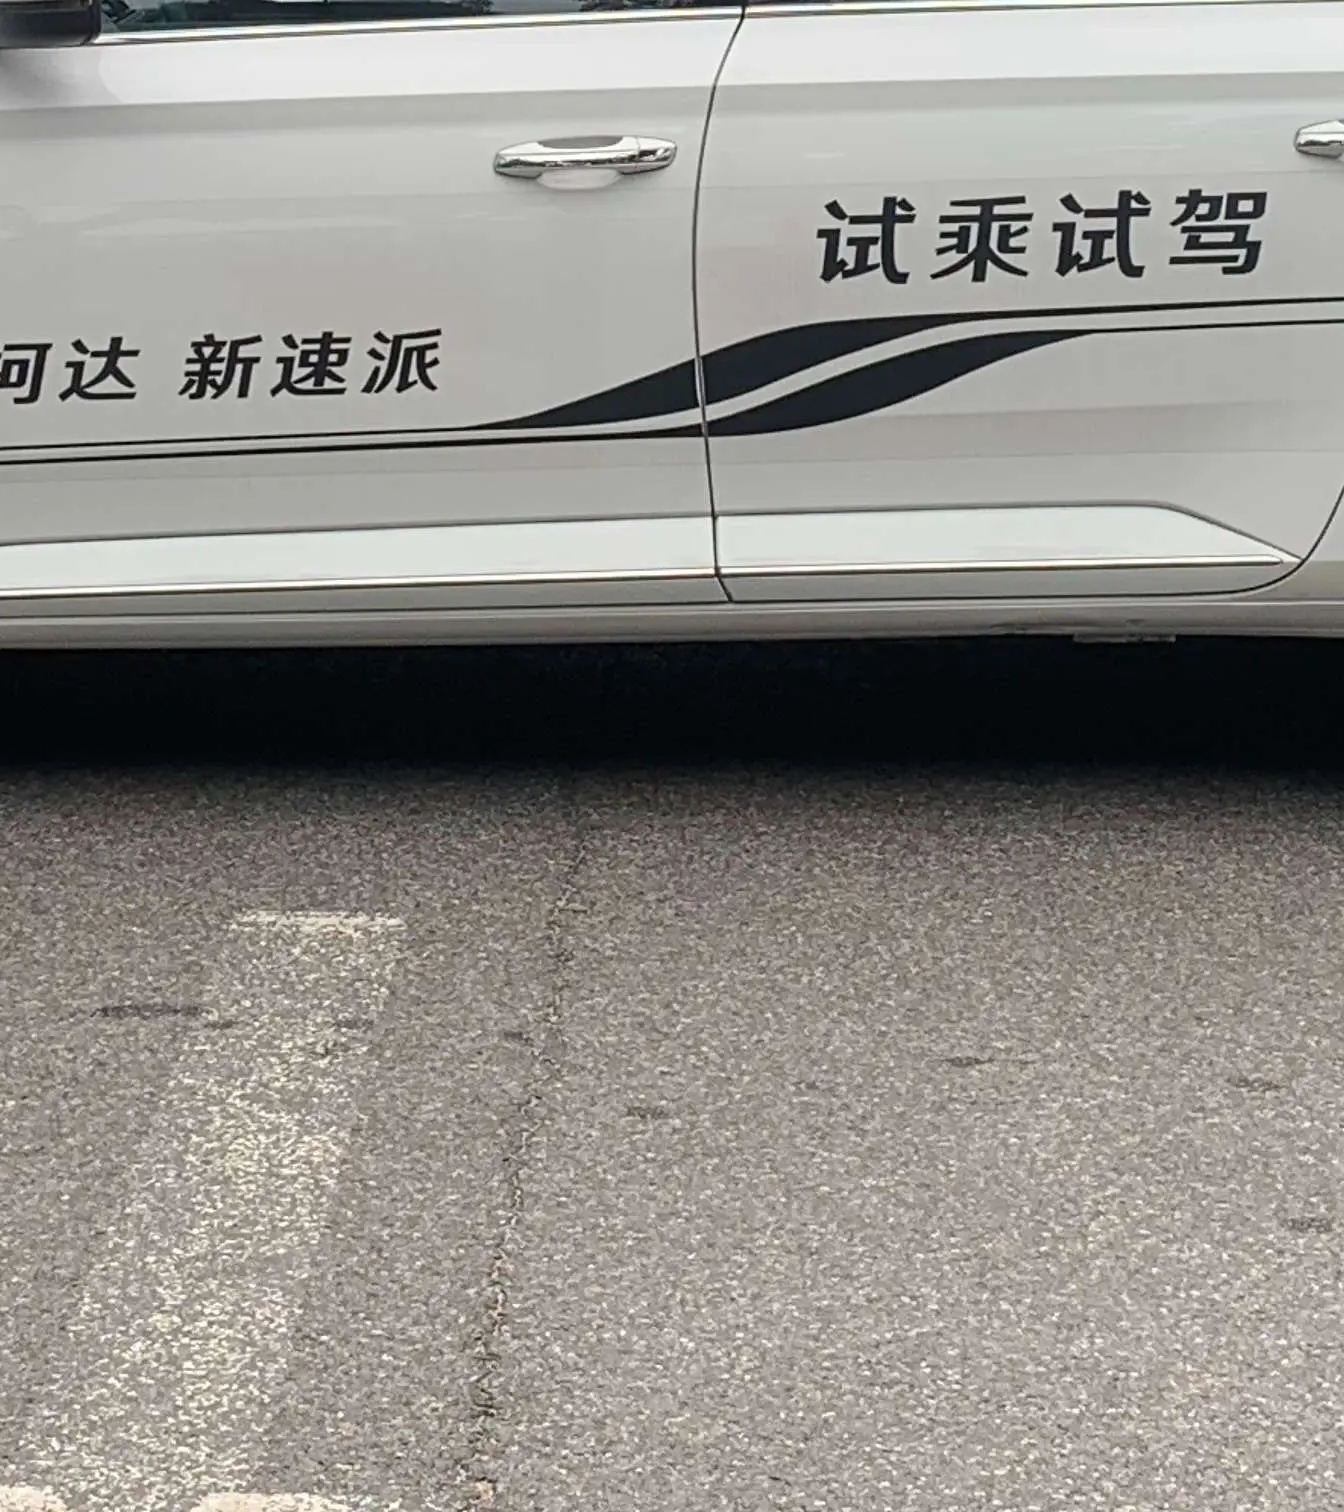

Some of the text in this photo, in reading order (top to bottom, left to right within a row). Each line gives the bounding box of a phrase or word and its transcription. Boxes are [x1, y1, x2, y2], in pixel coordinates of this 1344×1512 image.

[816, 188, 1268, 285] 试乘试驾
[178, 328, 443, 401] 新速派
